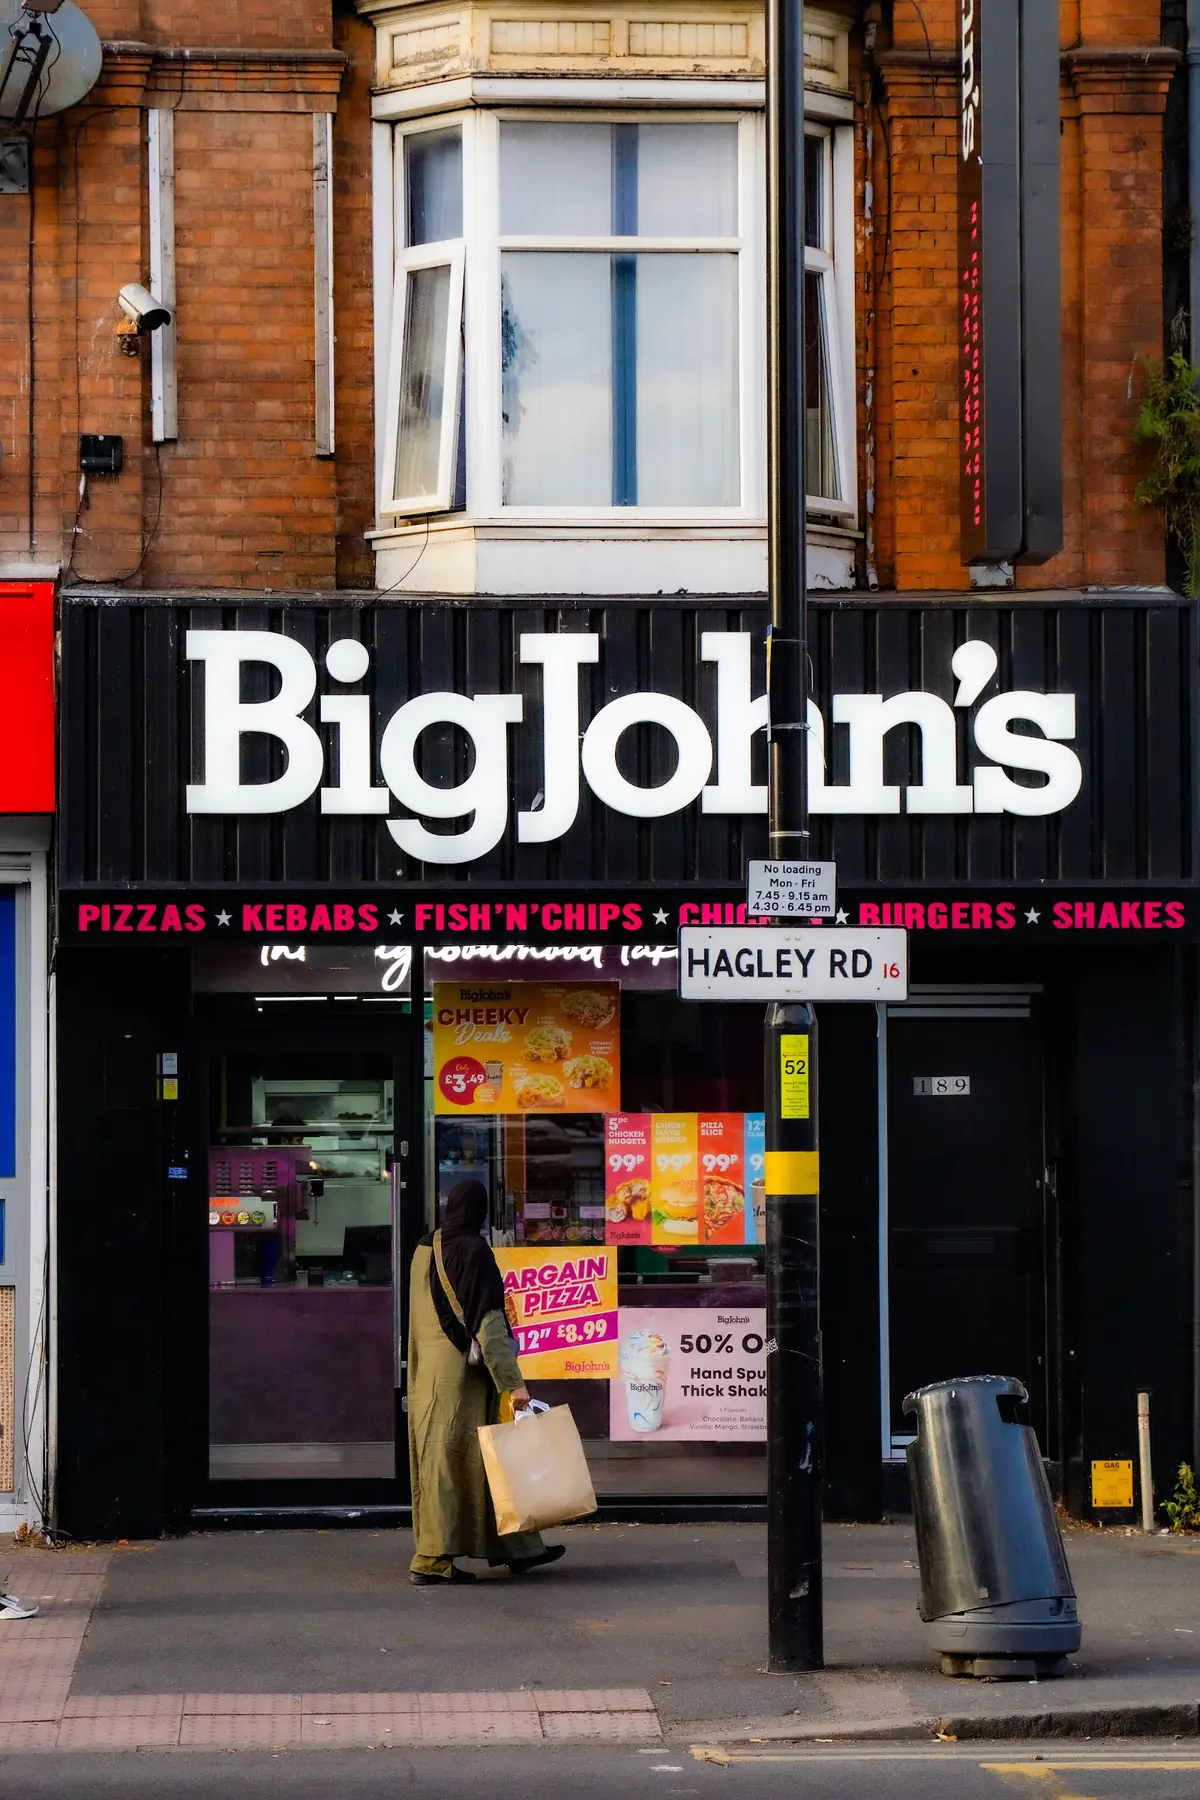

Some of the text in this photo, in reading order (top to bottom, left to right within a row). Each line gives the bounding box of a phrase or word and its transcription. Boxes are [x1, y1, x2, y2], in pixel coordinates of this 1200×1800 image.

[764, 864, 822, 876] No loading
[770, 879, 792, 889] Mon
[801, 879, 815, 888] Fri
[755, 891, 780, 900] 7.45
[788, 891, 811, 901] 9.15
[812, 893, 828, 901] am
[752, 902, 779, 911] 4.30
[787, 903, 812, 912] 6.45
[814, 904, 831, 913] pm
[78, 904, 206, 932] PIZZAS
[242, 904, 379, 932] KEBABS
[415, 903, 643, 932] FISH'N'CHIPS
[859, 902, 1016, 930] BURGERS
[1053, 901, 1185, 929] SHAKES
[687, 947, 815, 978] HAGLEY
[830, 949, 872, 978] RD
[883, 963, 900, 979] 16
[460, 989, 512, 1002] BigJohn's
[438, 1008, 530, 1027] CHEEKY
[455, 1021, 513, 1046] Deals
[785, 1060, 806, 1075] 52
[445, 1074, 485, 1093] £3.49
[920, 1079, 967, 1093] 189
[610, 1232, 641, 1240] BigJohn's
[503, 1256, 608, 1294] ARGAIN
[523, 1283, 602, 1318] PIZZA
[717, 1316, 750, 1324] BigJohn's
[556, 1318, 608, 1343] £8.99
[680, 1334, 734, 1354] 50%
[565, 1361, 610, 1373] BigJohn's
[690, 1367, 766, 1382] Hand Spu
[680, 1385, 767, 1397] Thick Shak
